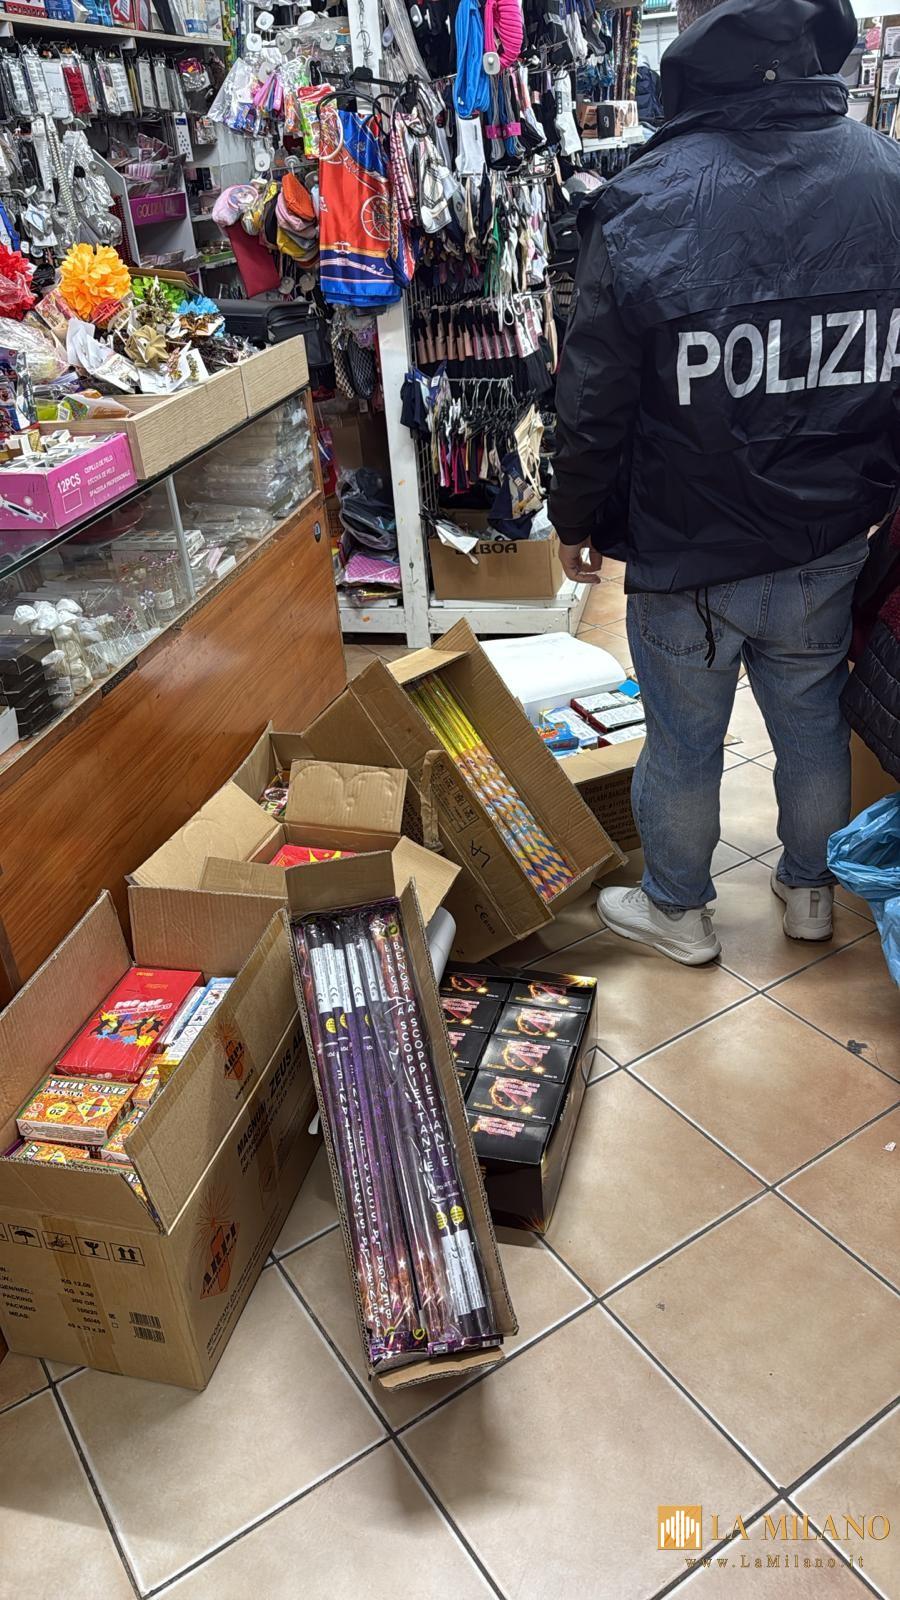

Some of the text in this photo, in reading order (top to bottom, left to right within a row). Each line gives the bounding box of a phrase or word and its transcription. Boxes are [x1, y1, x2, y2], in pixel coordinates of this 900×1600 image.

[57, 472, 82, 494] 12PCS
[393, 941, 417, 1014] BENGALA
[90, 1084, 128, 1095] ZEUS
[400, 1021, 435, 1172] SCOPPIETTANTE
[410, 1017, 450, 1167] SCOPPIETTANTE
[236, 1101, 269, 1157] MAGNUM
[268, 1048, 292, 1098] ZEUS
[49, 1108, 63, 1116] 20
[3, 1292, 33, 1303] PACKING
[64, 1287, 75, 1295] KG
[5, 1301, 37, 1312] PACKING
